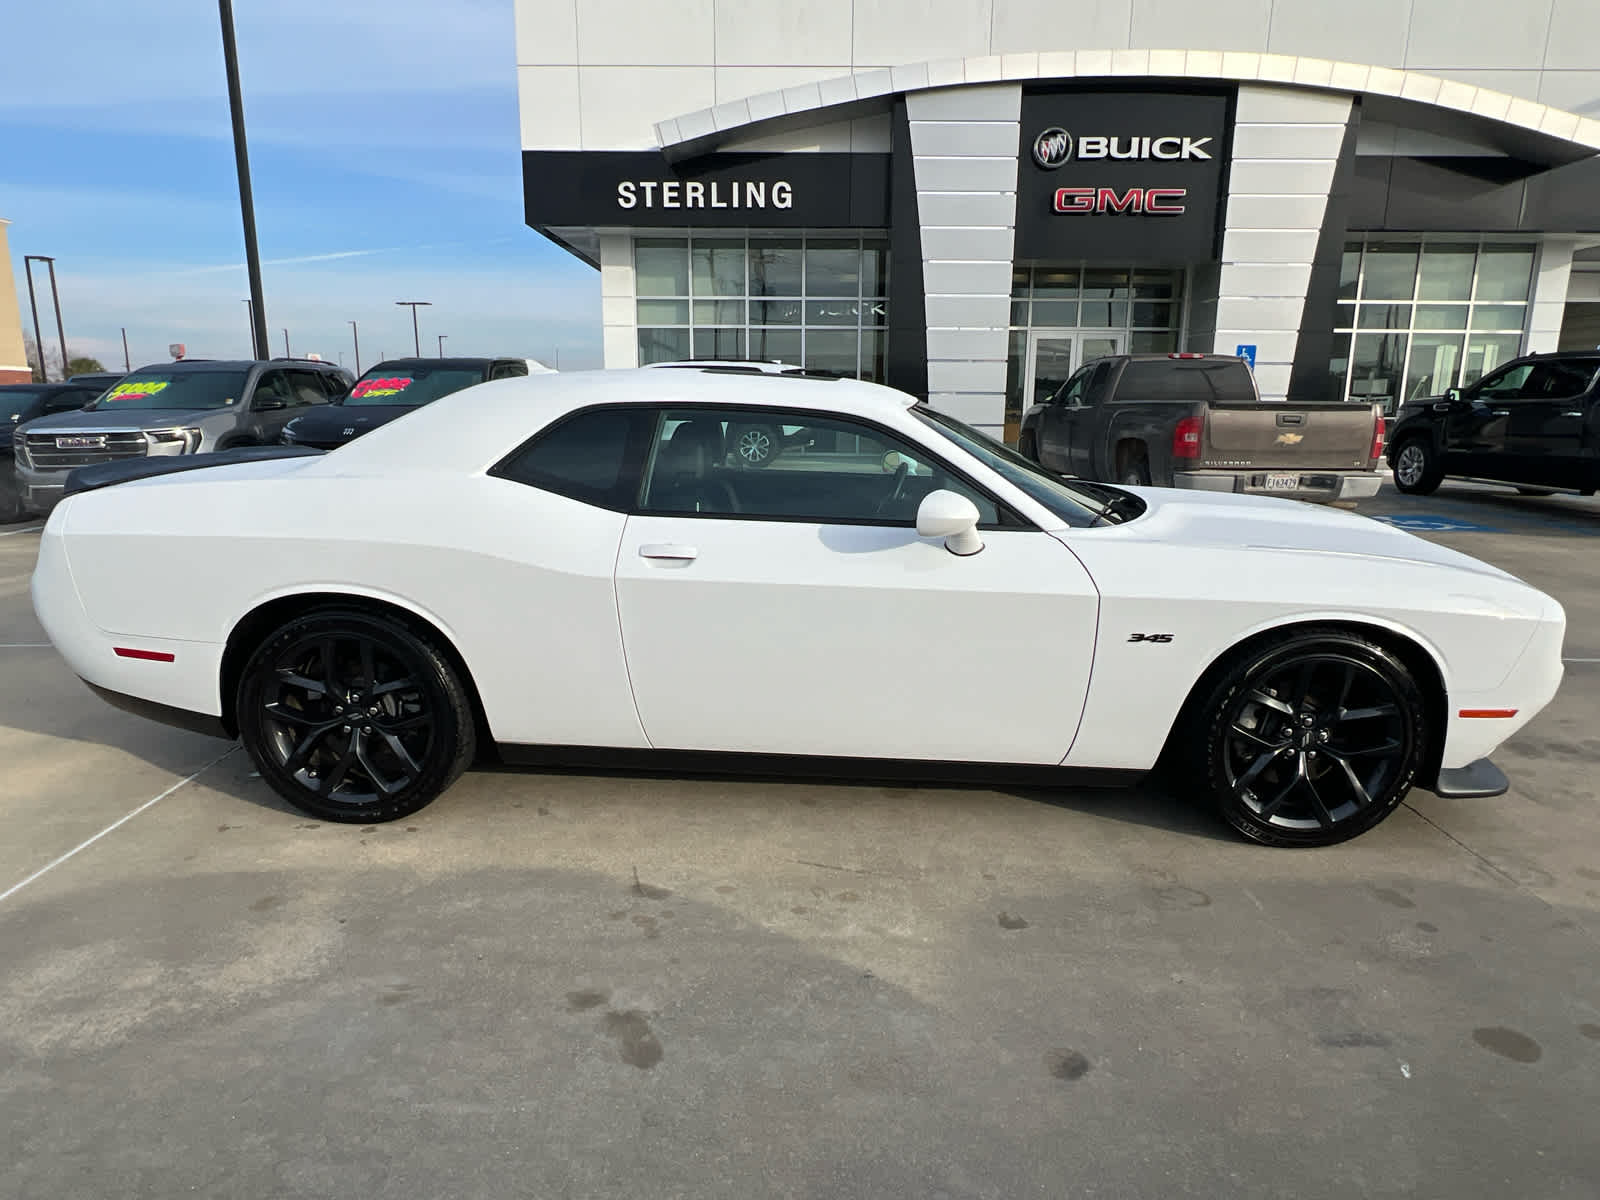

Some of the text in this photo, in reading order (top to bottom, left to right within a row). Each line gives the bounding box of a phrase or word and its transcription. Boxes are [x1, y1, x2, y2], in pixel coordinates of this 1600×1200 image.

[1078, 136, 1213, 159] BUICK
[617, 181, 793, 209] STERLING
[1054, 187, 1187, 214] GMC
[1127, 633, 1174, 643] 345
